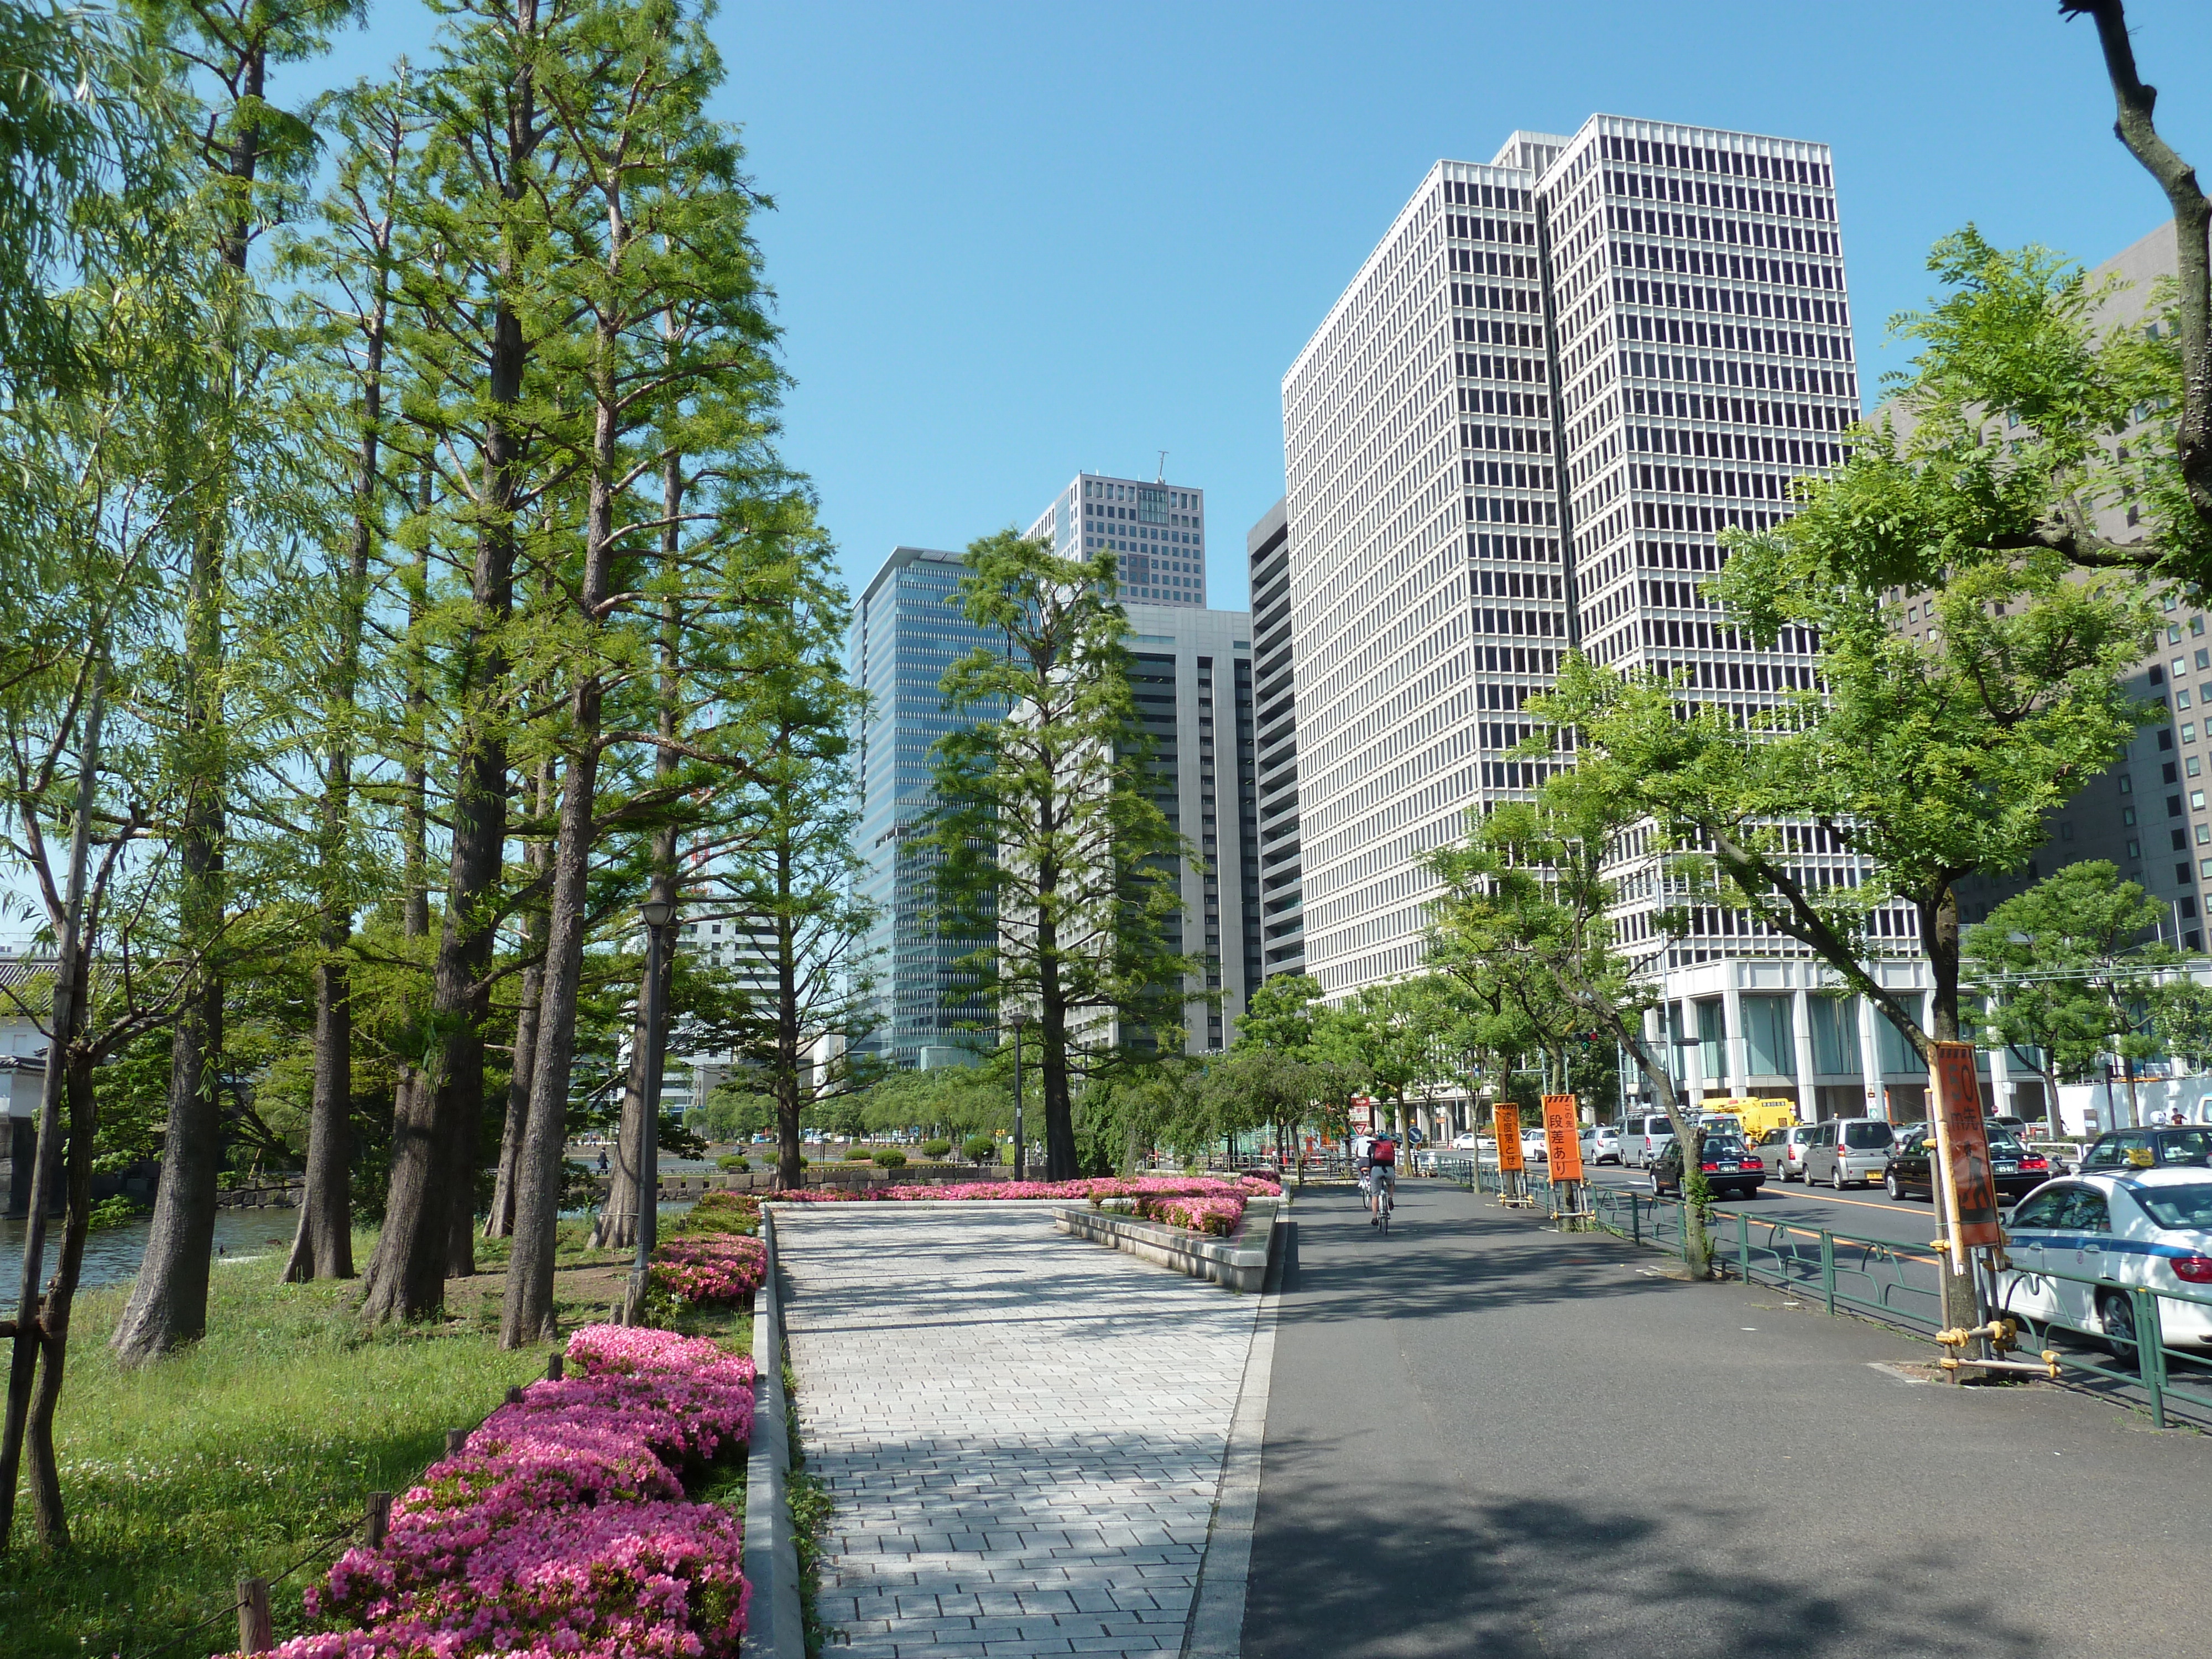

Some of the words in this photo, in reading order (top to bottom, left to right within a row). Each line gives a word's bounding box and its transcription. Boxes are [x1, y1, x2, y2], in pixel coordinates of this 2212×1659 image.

[1948, 1064, 1973, 1102] 50
[1503, 1112, 1516, 1166] 速度落とせ
[1565, 1104, 1573, 1128] この先
[1550, 1114, 1566, 1175] 段差あり
